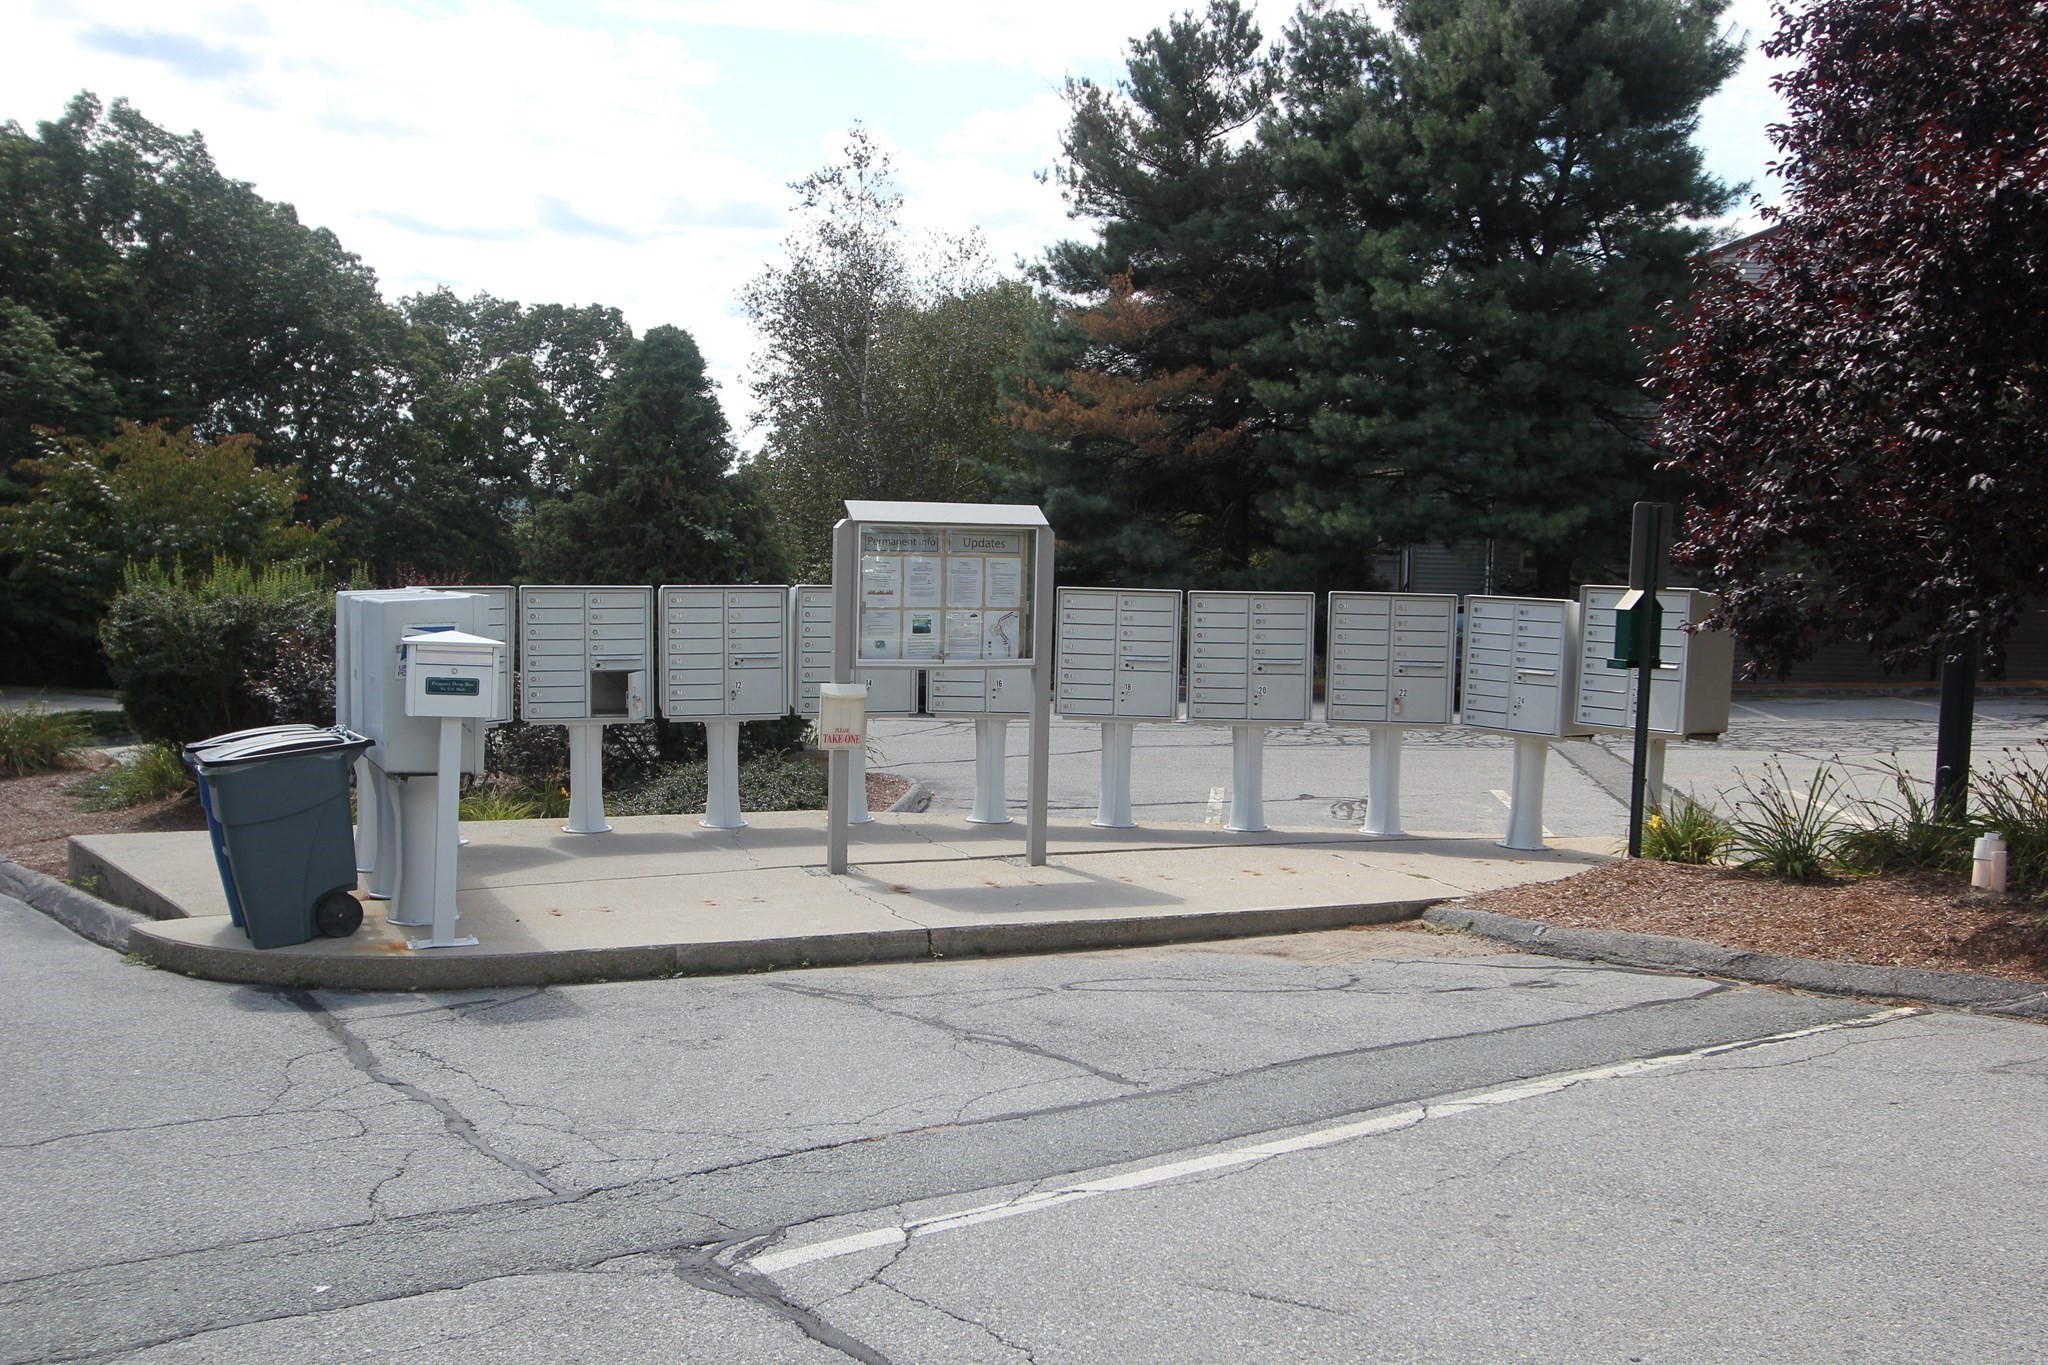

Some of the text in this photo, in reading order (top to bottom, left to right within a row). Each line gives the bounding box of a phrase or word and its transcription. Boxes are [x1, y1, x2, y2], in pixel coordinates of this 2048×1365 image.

[867, 536, 936, 547] Permanent Info
[963, 537, 1006, 550] Updates
[866, 679, 872, 687] 14
[1258, 686, 1267, 694] 20
[1399, 689, 1408, 697] 22
[823, 734, 861, 744] TAKE ONE
